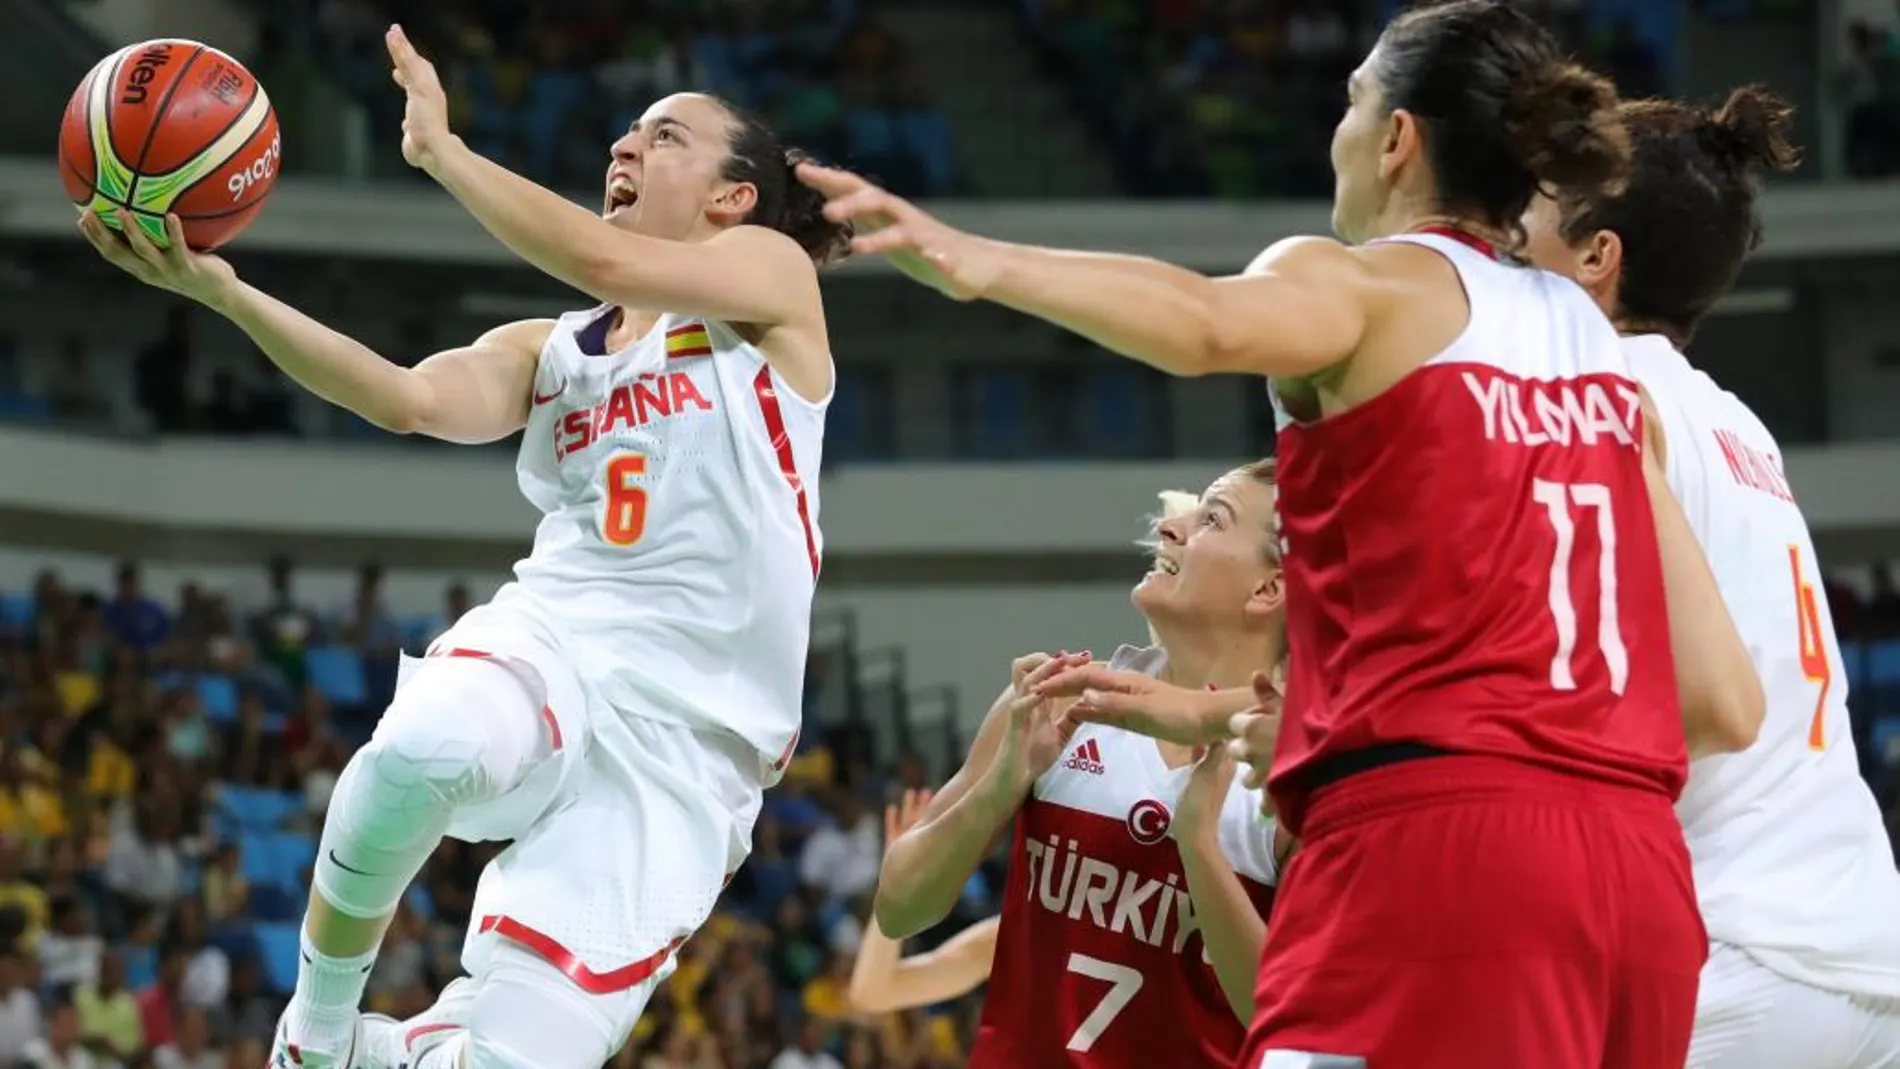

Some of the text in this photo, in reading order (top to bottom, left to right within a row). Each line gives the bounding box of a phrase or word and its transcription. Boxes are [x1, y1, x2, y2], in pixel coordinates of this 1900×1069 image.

[601, 450, 650, 547] 6
[1786, 542, 1832, 752] 4
[1062, 752, 1105, 775] adidas
[1025, 833, 1214, 966] TÜRKİY
[1066, 952, 1145, 1054] 7
